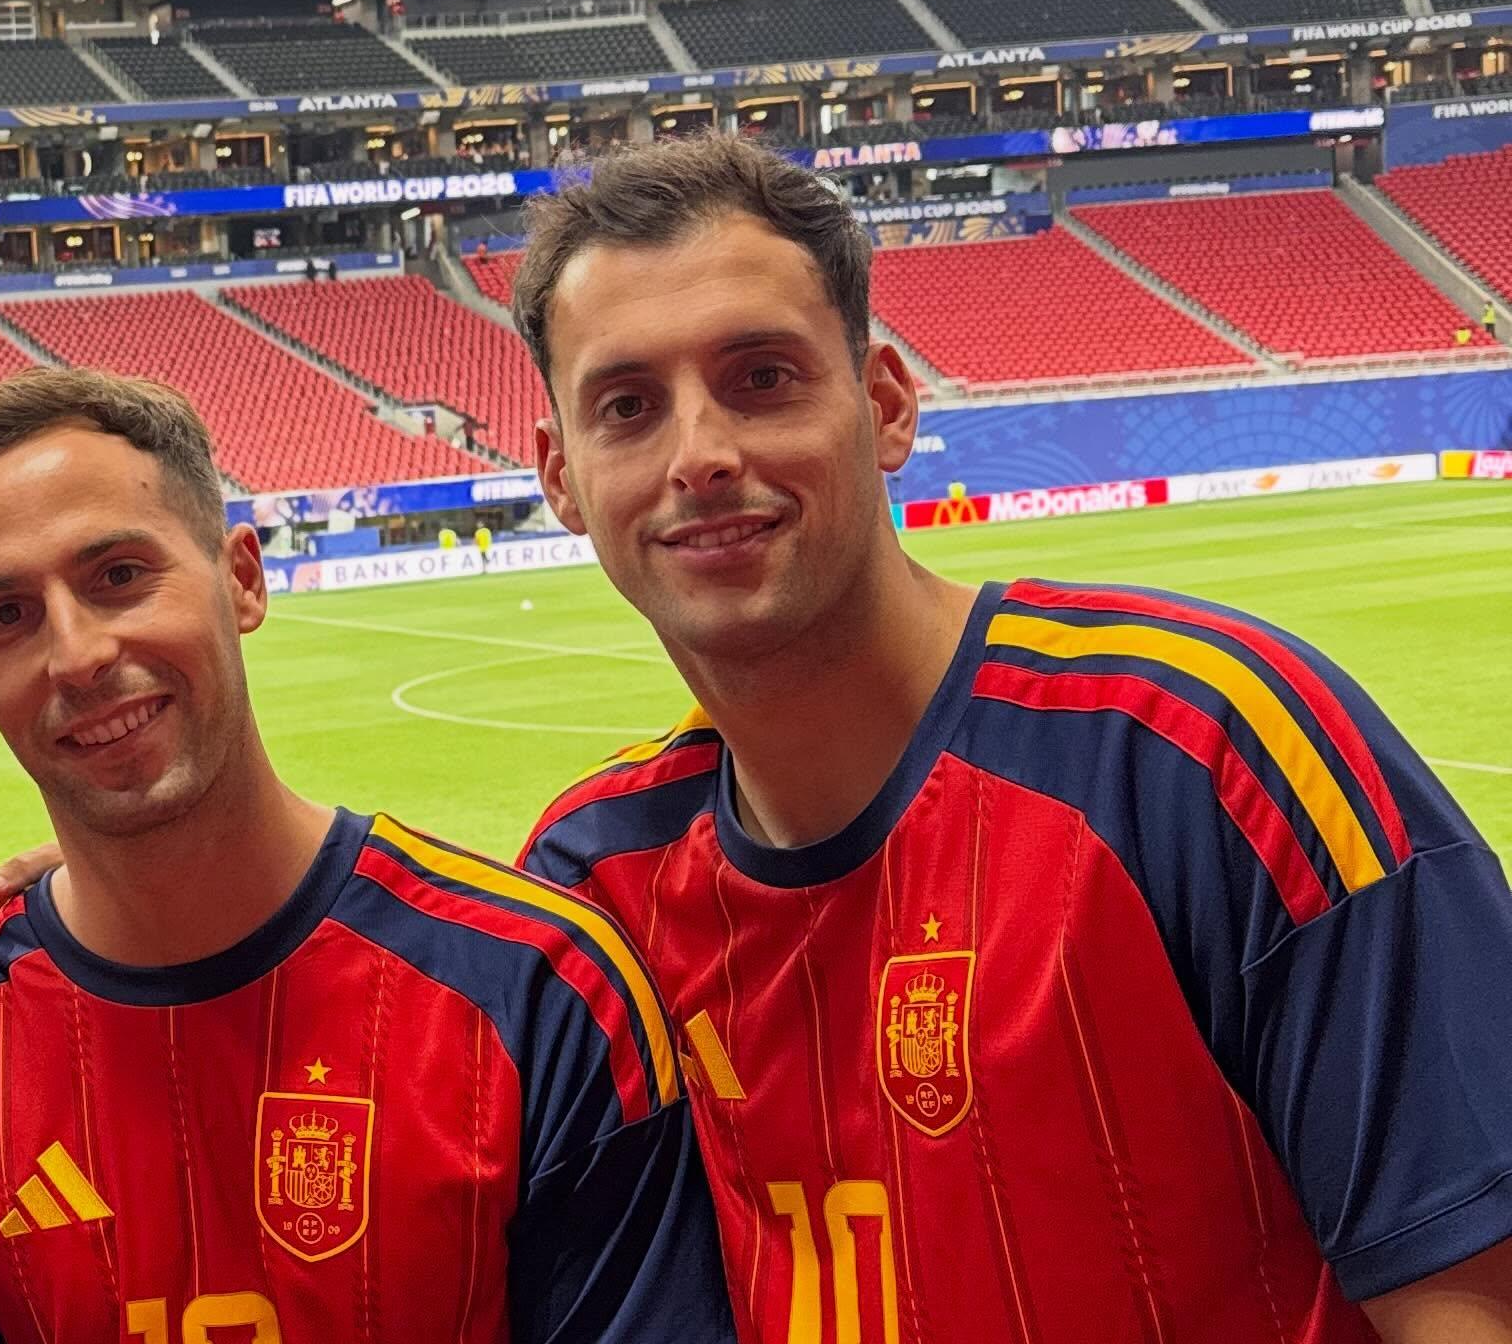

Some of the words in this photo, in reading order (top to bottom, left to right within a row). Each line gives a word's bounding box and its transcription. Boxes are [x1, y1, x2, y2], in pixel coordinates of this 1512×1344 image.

[1326, 22, 1380, 39] WORLD
[1381, 18, 1414, 35] CUP
[1414, 13, 1473, 32] 2026
[938, 46, 1046, 69] ATLANTA
[298, 93, 397, 113] ATLANTA
[1470, 98, 1512, 116] WOR
[814, 142, 922, 169] ATLANTA
[284, 182, 340, 208] FIFA
[340, 178, 403, 206] WORLD
[404, 176, 444, 201] CUP
[445, 172, 516, 198] 2026
[868, 206, 923, 222] WORLD
[924, 203, 953, 220] CUP
[989, 481, 1148, 522] McDonald's
[335, 561, 409, 585] BANK
[418, 555, 451, 575] OF
[461, 543, 583, 571] AMERICA
